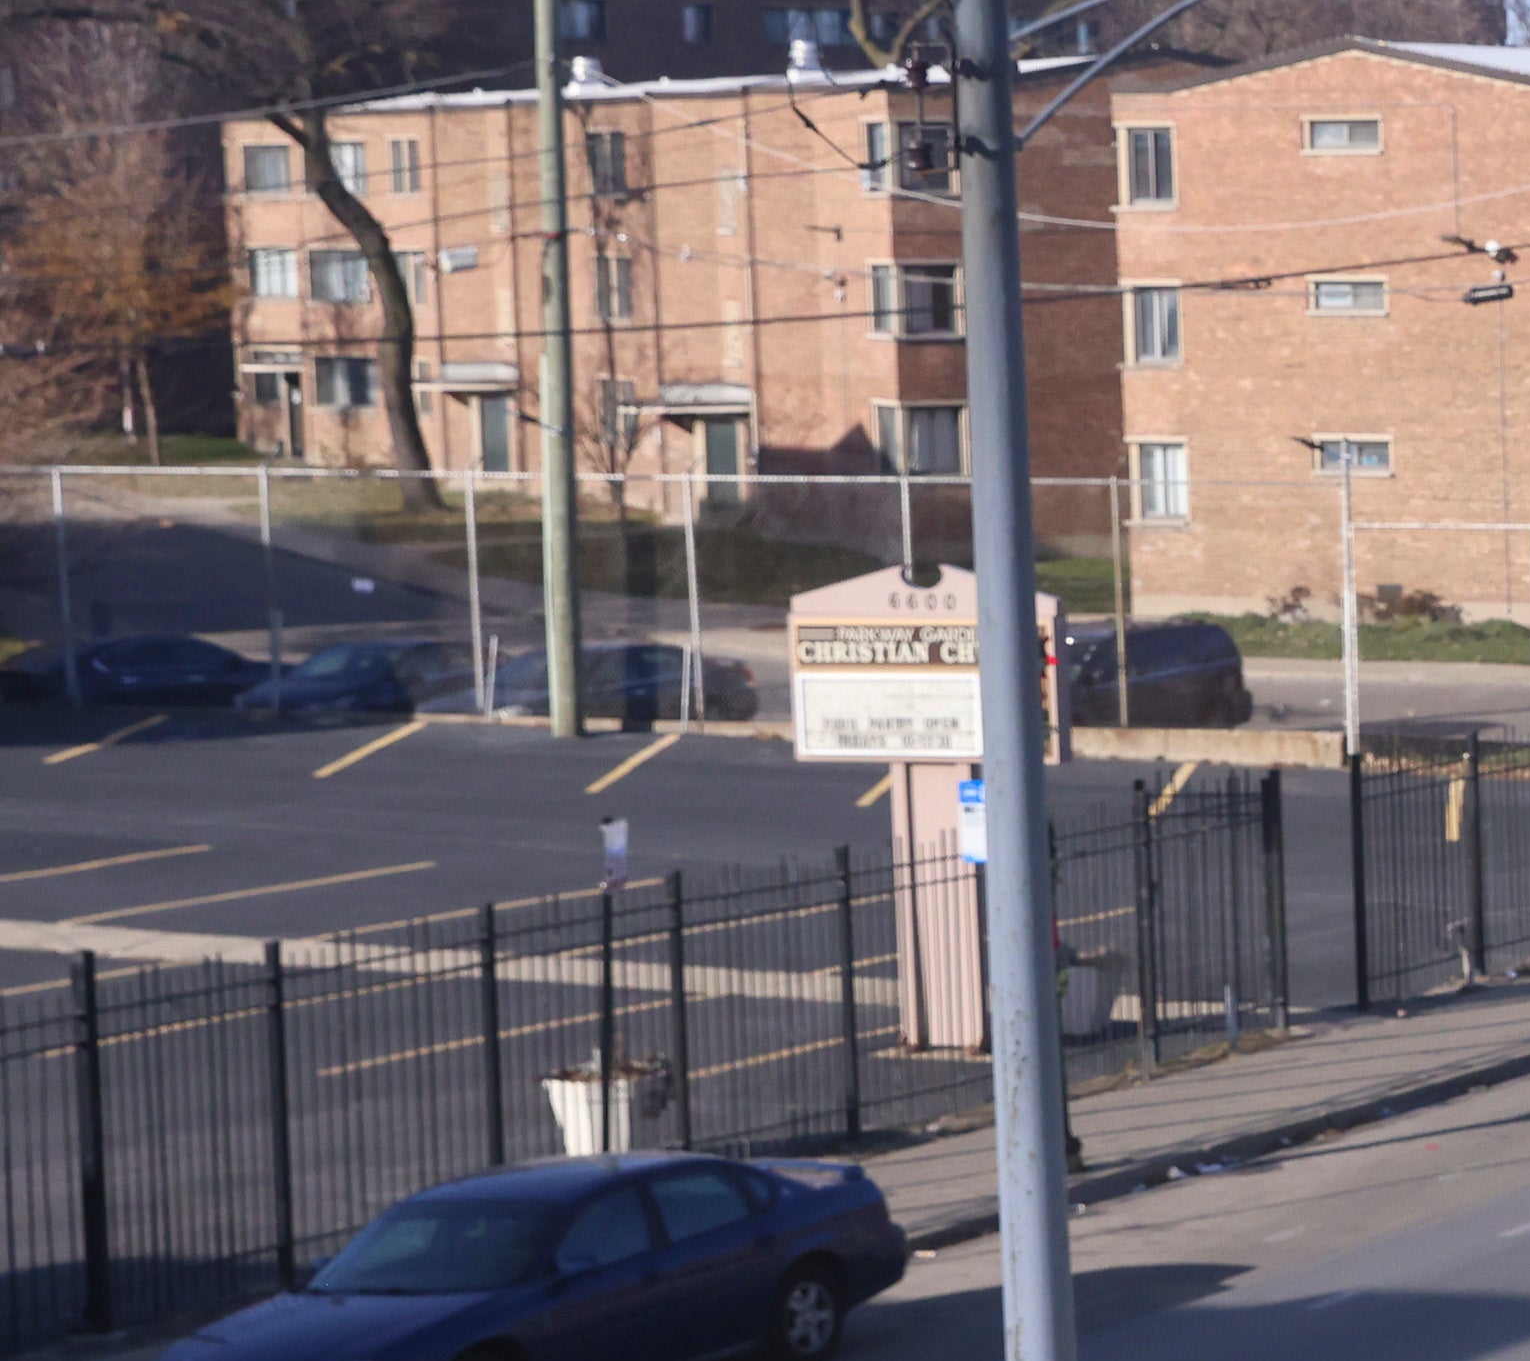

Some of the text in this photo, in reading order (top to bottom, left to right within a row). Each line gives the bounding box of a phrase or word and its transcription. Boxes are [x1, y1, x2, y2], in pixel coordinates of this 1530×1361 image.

[889, 592, 957, 611] 6600
[838, 625, 915, 642] PARKWAY
[797, 640, 979, 664] CHRISTIAN CH
